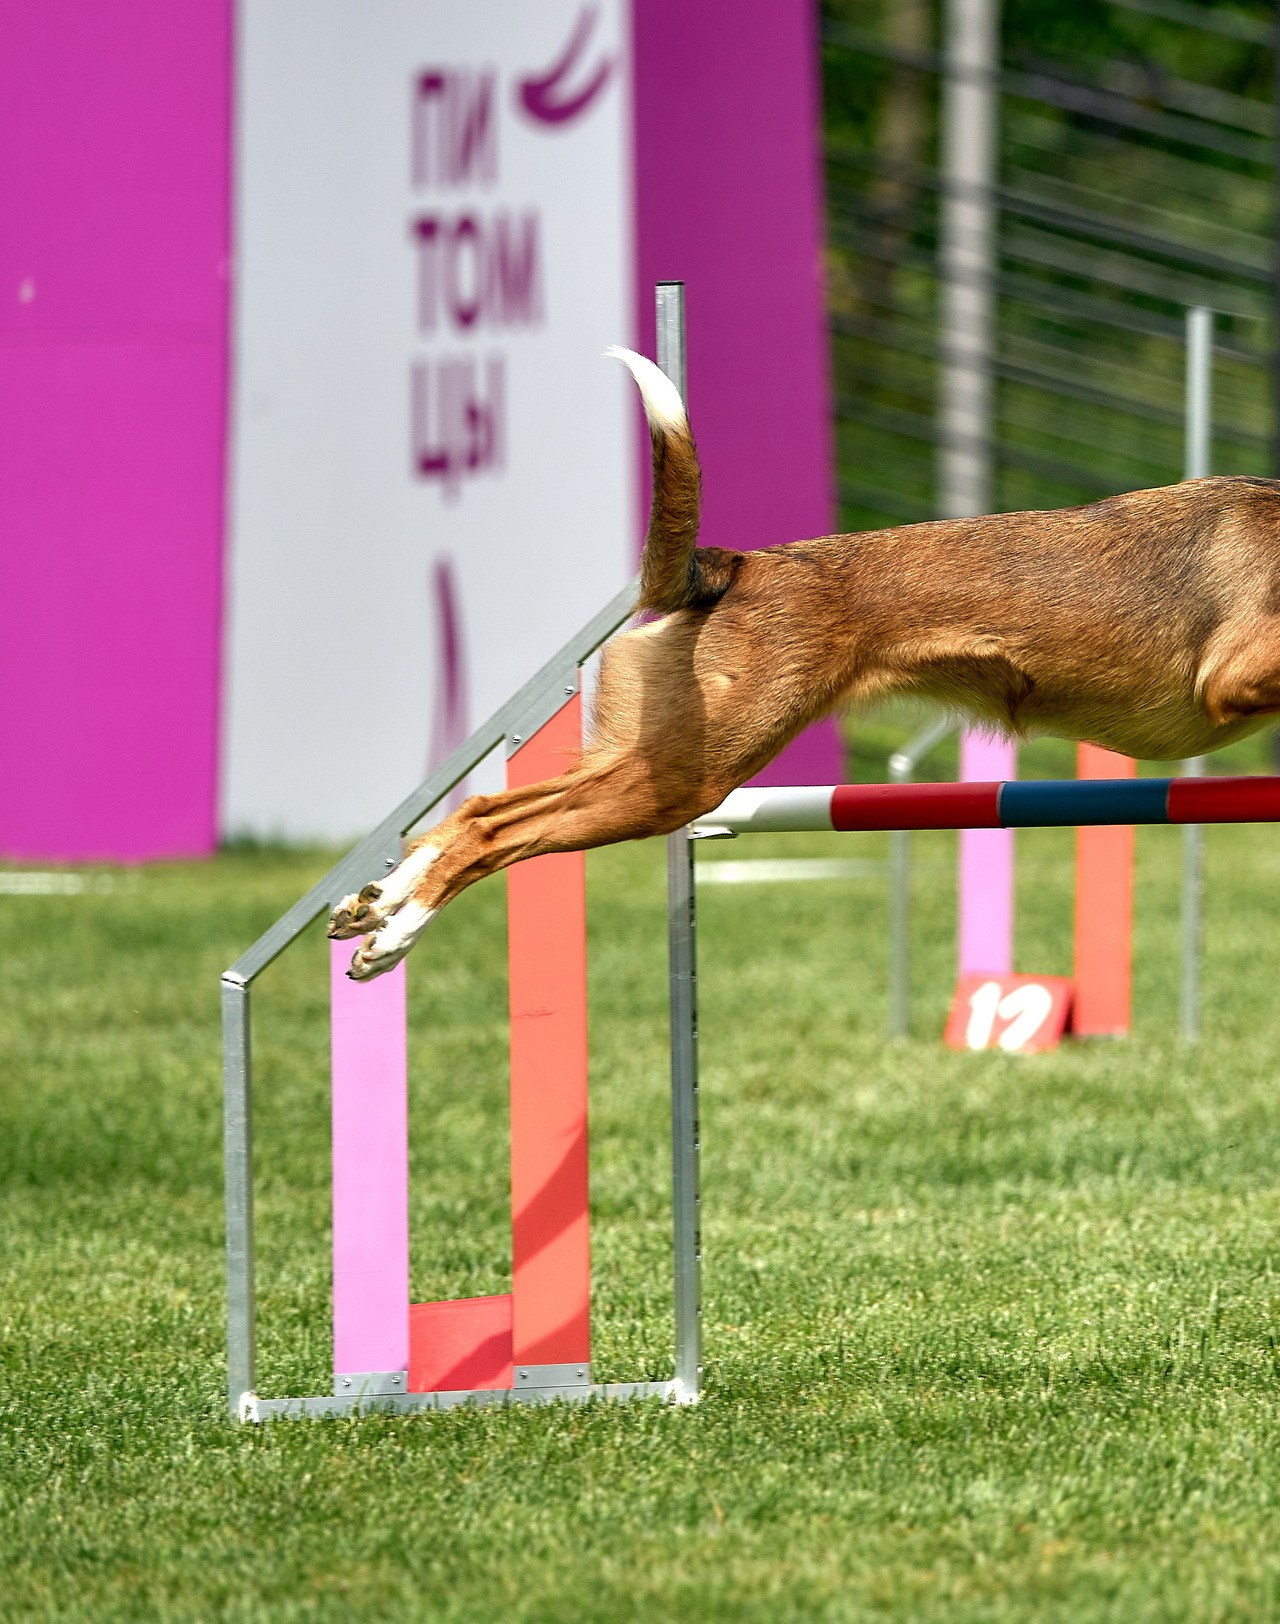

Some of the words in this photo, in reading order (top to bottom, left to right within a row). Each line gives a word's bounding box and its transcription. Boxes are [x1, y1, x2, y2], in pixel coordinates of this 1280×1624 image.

[410, 66, 499, 190] ПИ
[411, 212, 545, 338] ТОМ
[410, 354, 504, 507] ЦЫ
